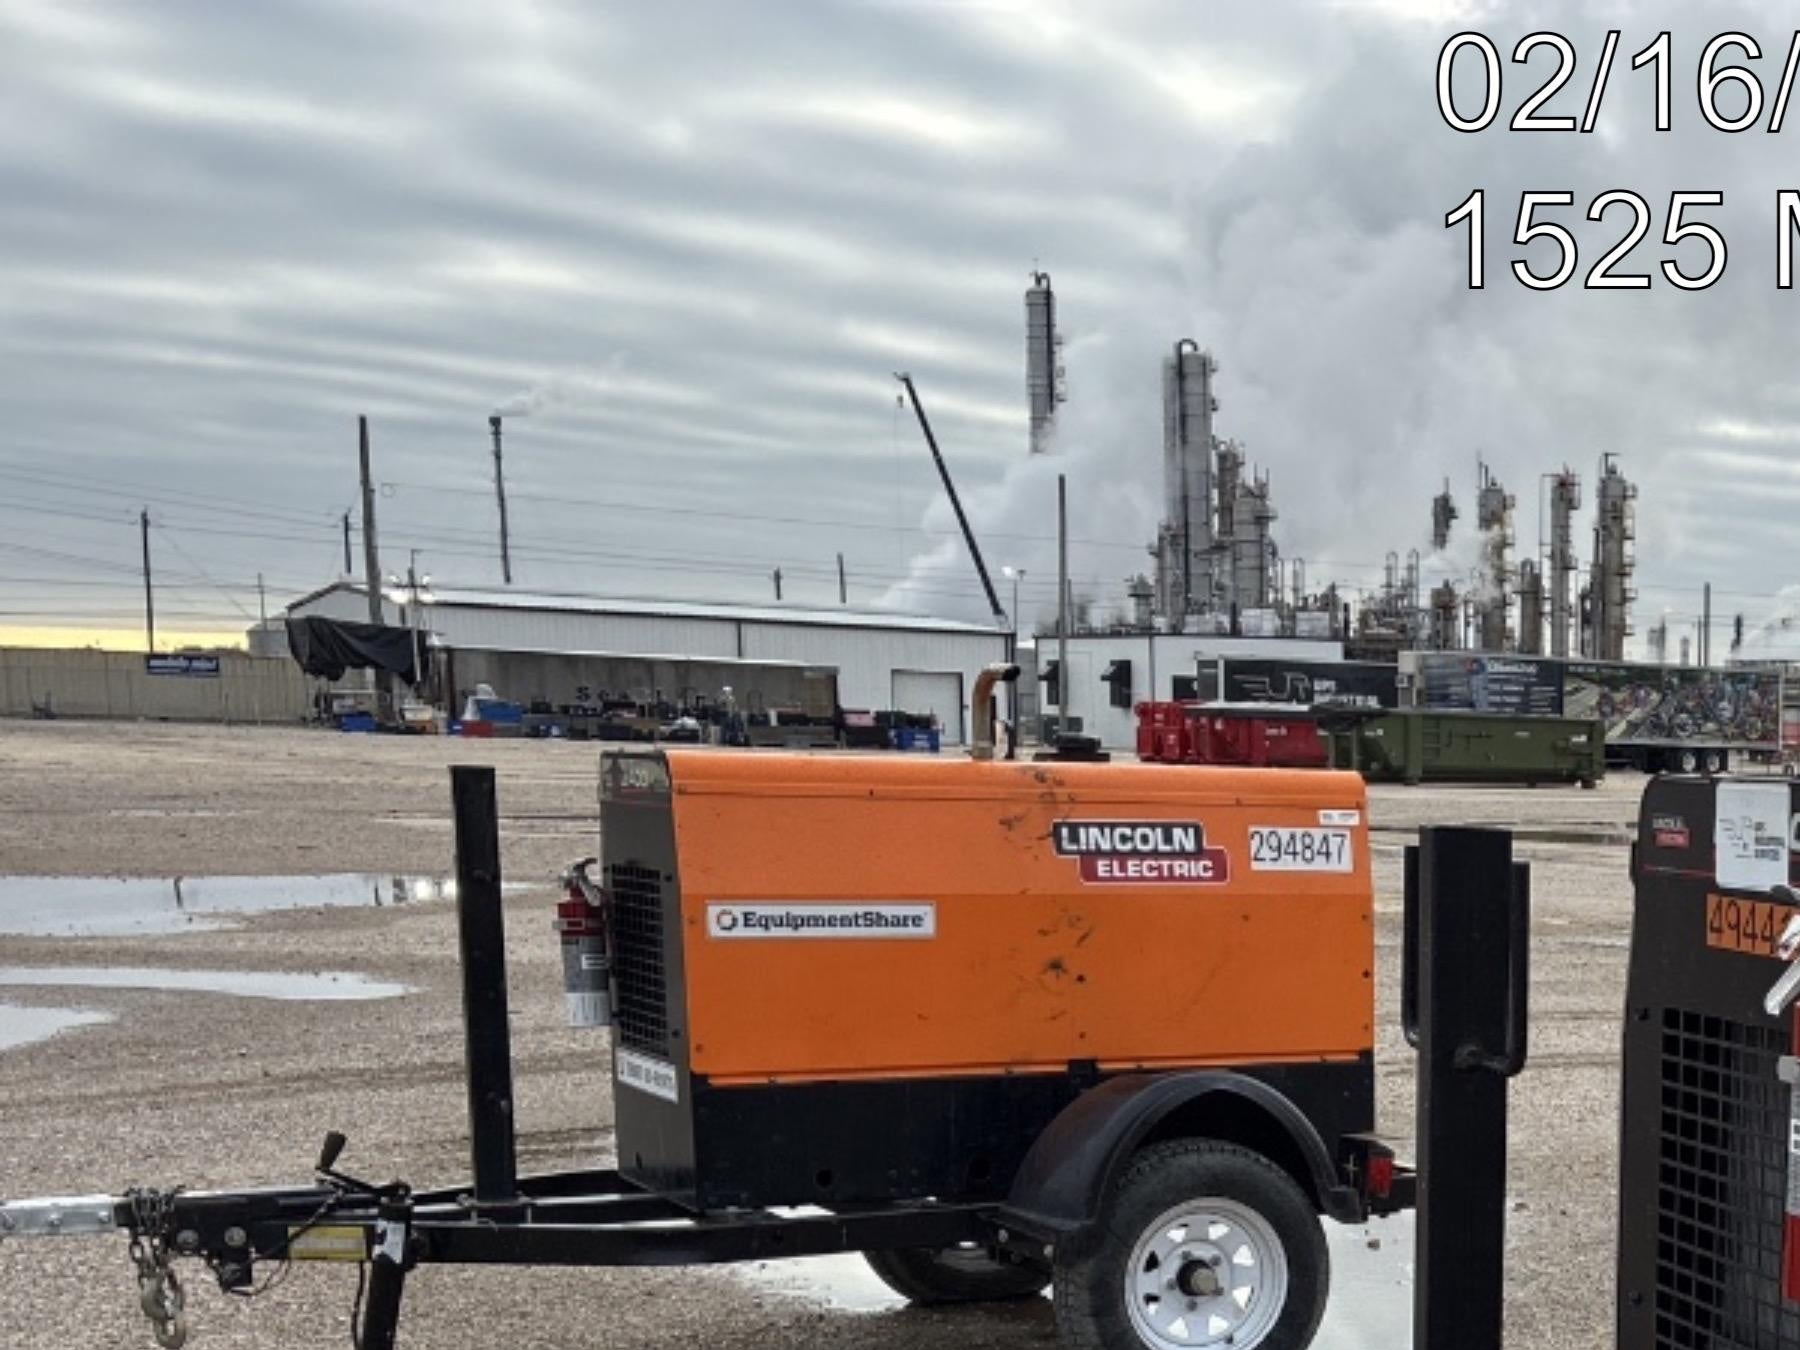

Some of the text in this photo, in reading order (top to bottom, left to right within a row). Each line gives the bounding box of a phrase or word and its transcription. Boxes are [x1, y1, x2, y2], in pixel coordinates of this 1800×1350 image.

[1060, 826, 1195, 851] LINCOLN
[1250, 830, 1347, 865] 294847
[1097, 858, 1214, 878] ELECTRIC
[742, 910, 926, 931] EquipmentShare
